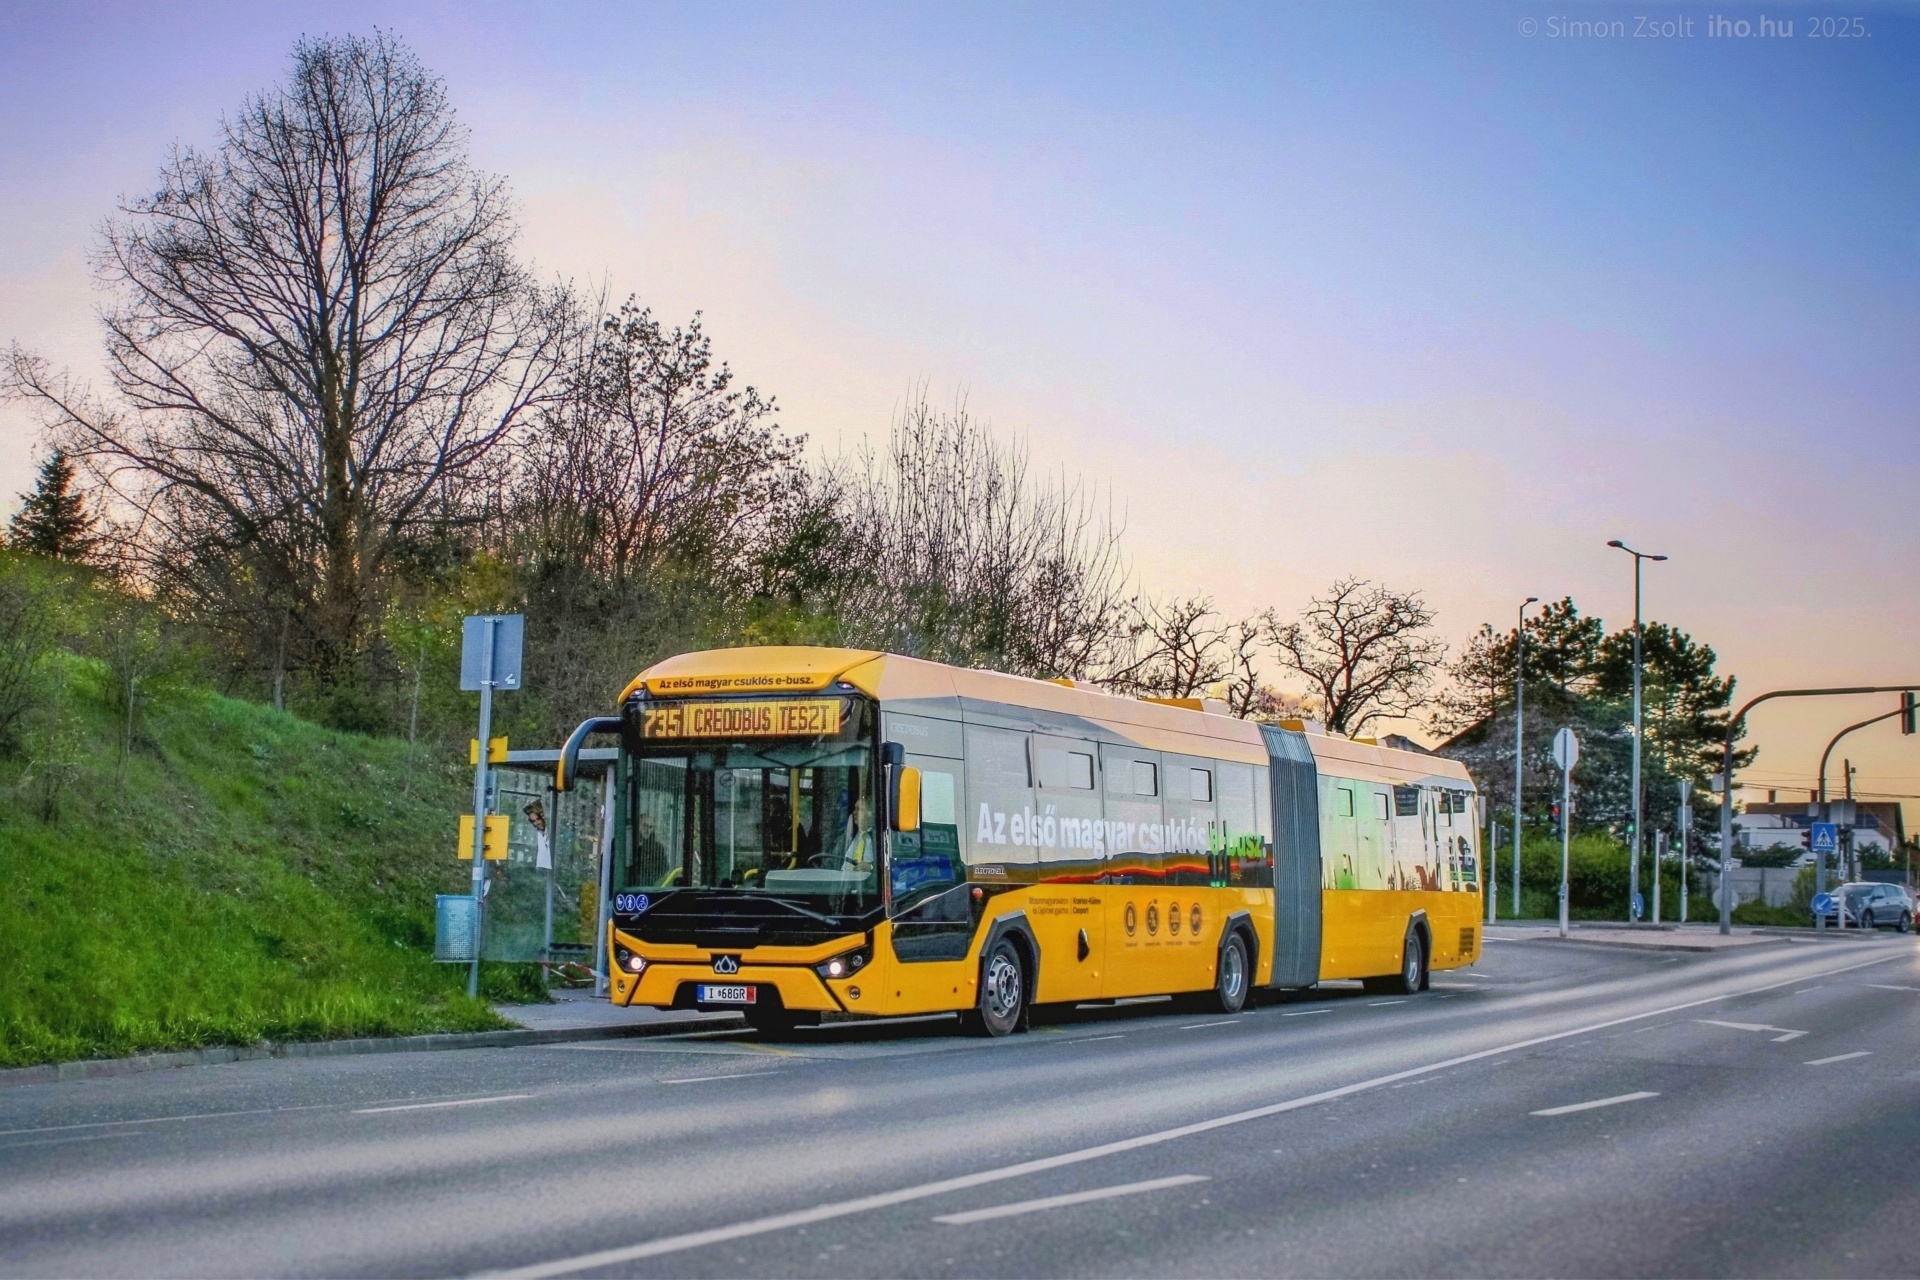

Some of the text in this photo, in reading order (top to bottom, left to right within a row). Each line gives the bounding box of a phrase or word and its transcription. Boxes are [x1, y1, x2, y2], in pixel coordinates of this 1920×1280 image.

[659, 675, 814, 689] Az első magyar csuklós e-busz.
[644, 704, 829, 738] 735 CREDOBUS TESZT
[976, 802, 1007, 846] Az
[1010, 803, 1057, 848] első
[1059, 817, 1135, 860] magyar
[1138, 816, 1207, 855] csuklós
